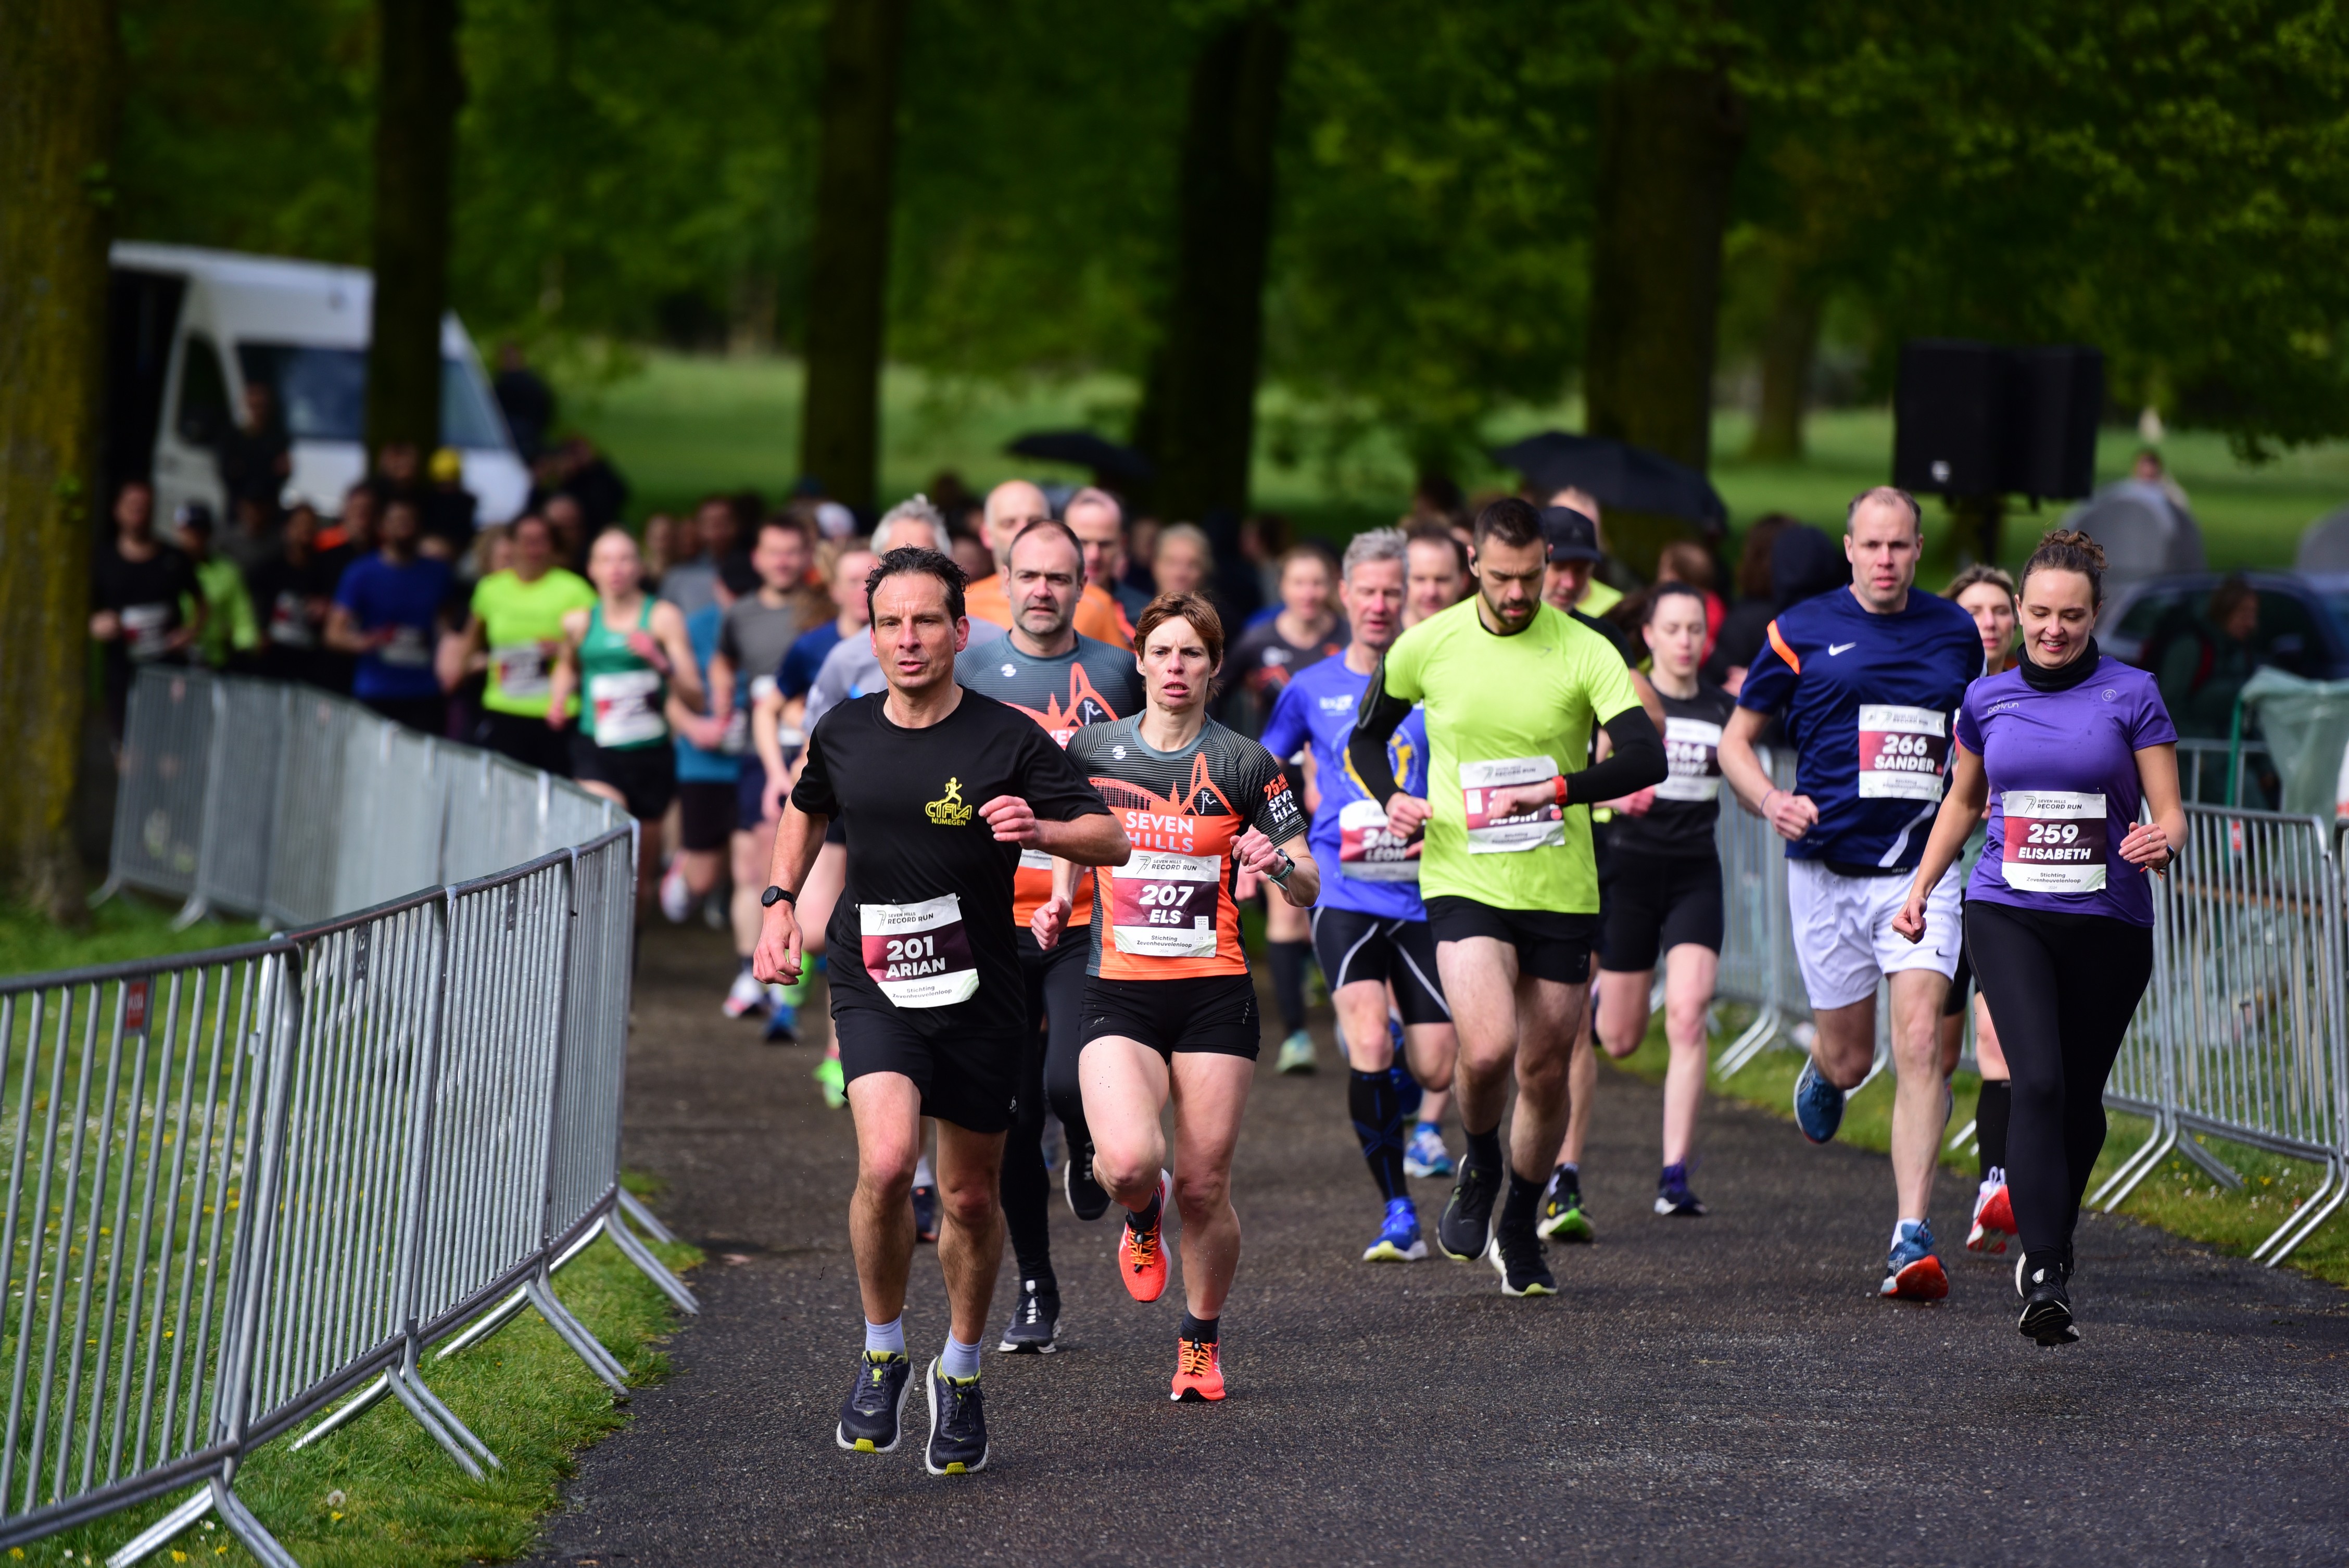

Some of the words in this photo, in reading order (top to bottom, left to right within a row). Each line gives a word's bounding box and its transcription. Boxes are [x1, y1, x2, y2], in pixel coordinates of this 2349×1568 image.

[1988, 702, 2019, 715] parkrun
[1883, 734, 1927, 756] 266
[1874, 754, 1935, 773] SANDER
[1264, 778, 1280, 801] 25
[925, 801, 973, 820] CIFLA
[931, 817, 966, 826] NIJMEGEN
[1126, 811, 1193, 835] SEVEN
[1126, 831, 1194, 853] HILLS
[2027, 823, 2079, 844] 259
[2018, 847, 2091, 859] ELISABETH
[1139, 884, 1194, 906] 207
[918, 913, 934, 922] RUN
[1149, 909, 1182, 924] ELS
[887, 935, 933, 961] 201
[886, 957, 945, 979] ARIAN
[892, 989, 952, 998] Zevenheuvelenloop
